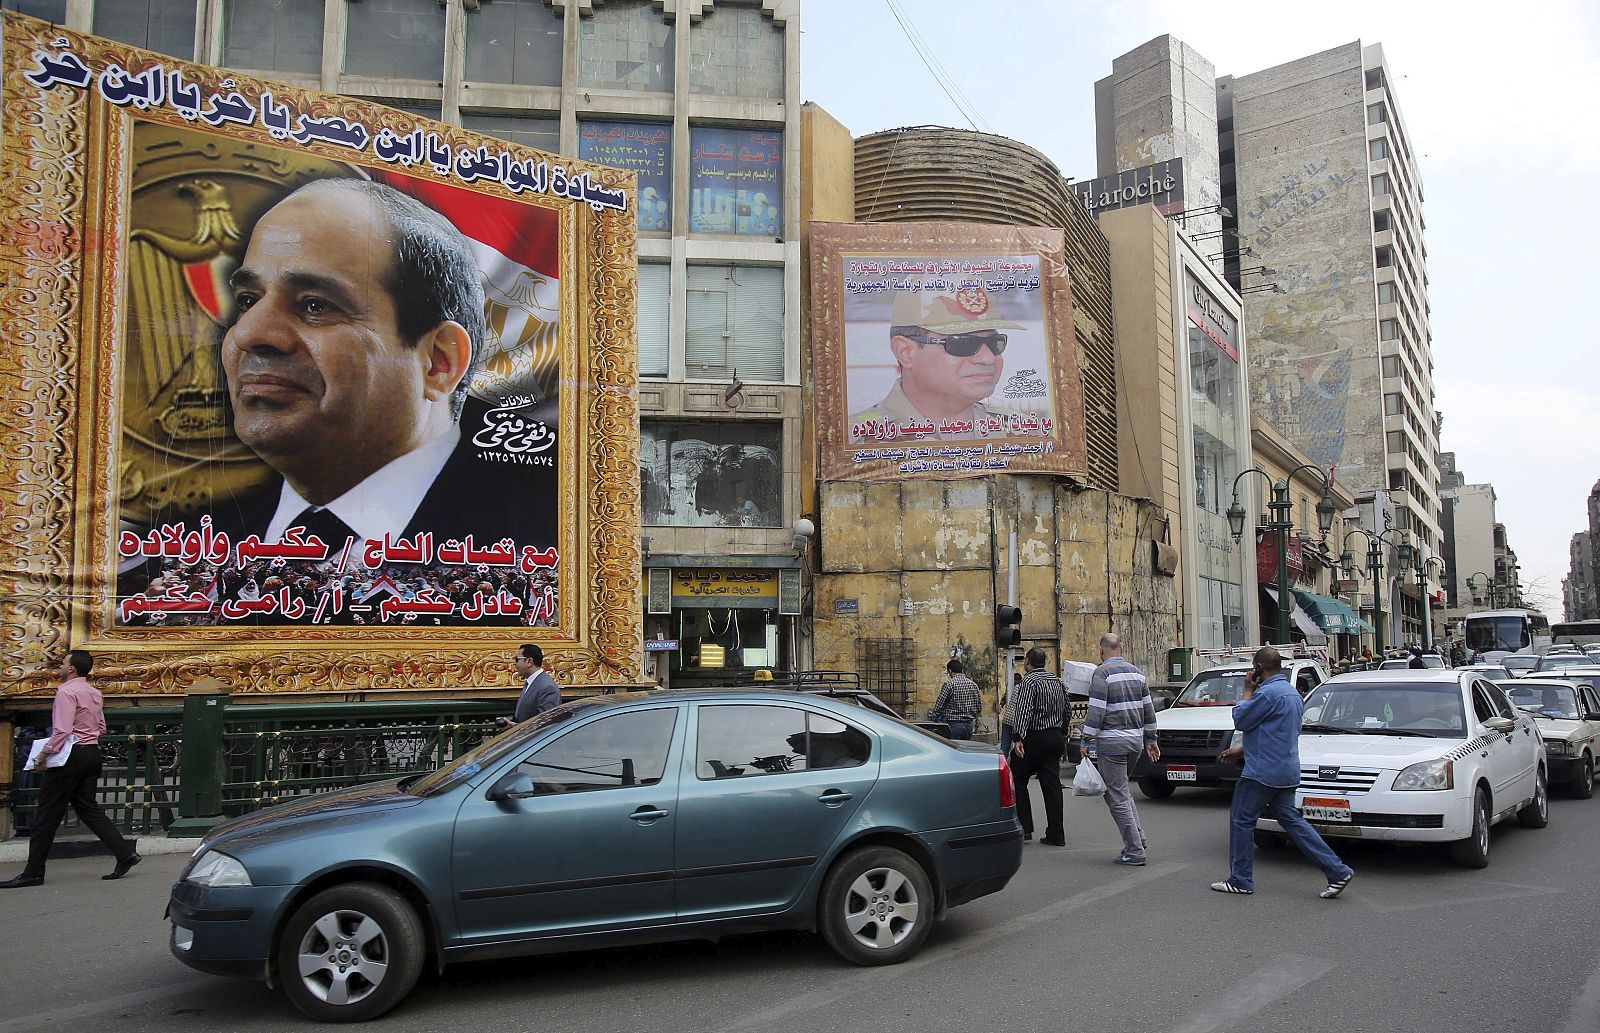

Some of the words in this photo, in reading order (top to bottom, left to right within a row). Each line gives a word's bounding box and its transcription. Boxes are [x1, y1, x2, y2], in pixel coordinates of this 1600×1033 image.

[100, 65, 164, 108] ابن
[168, 70, 200, 119] يا
[261, 93, 289, 138] يا
[288, 115, 369, 149] مصر
[374, 128, 424, 165] ابن
[427, 133, 450, 174] يا
[455, 146, 548, 192] المواطن
[552, 166, 626, 210] سيادة
[1083, 175, 1175, 209] Laroche
[888, 261, 924, 273] للصناعة
[963, 260, 996, 275] الضيوف
[998, 260, 1032, 273] مجموعة
[846, 278, 890, 293] الجمهورية
[957, 279, 983, 291] البطل
[986, 275, 1015, 290] ترشيح
[900, 417, 935, 438] ضيف
[940, 418, 973, 433] محمد
[1011, 413, 1038, 433] تحيات
[1041, 417, 1053, 435] مع
[478, 451, 553, 466] ٠١٢٢٥٦٧٨٥٧٤
[881, 448, 904, 460] ضيف
[940, 446, 962, 457] ضيف
[1000, 443, 1021, 455] ضيف
[933, 460, 959, 470] السادة
[119, 515, 230, 566] وأولاده
[237, 526, 329, 570] حكيم
[363, 532, 432, 568] الحاج
[438, 534, 516, 572] تحيات
[521, 545, 559, 574] مع
[677, 569, 721, 586] دياب
[122, 585, 213, 621] حكيم
[381, 589, 455, 621] حكيم
[462, 591, 522, 619] عادل
